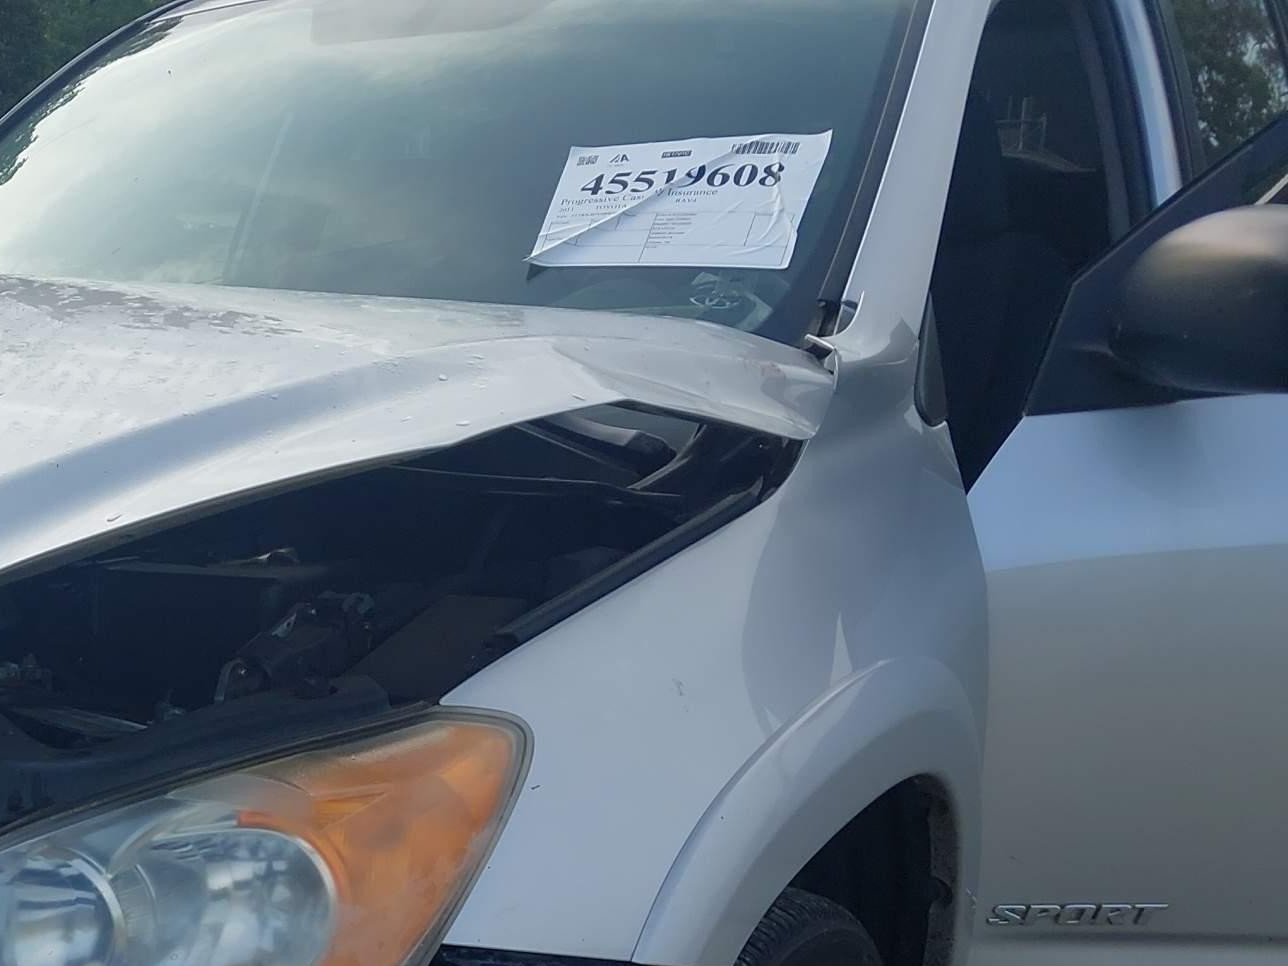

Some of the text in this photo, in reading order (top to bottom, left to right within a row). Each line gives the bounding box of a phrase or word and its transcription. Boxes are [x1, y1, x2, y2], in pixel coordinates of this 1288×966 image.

[581, 162, 785, 196] 45519608
[560, 195, 620, 206] Progressive
[667, 188, 718, 197] Insurance
[986, 903, 1169, 926] SPORT
